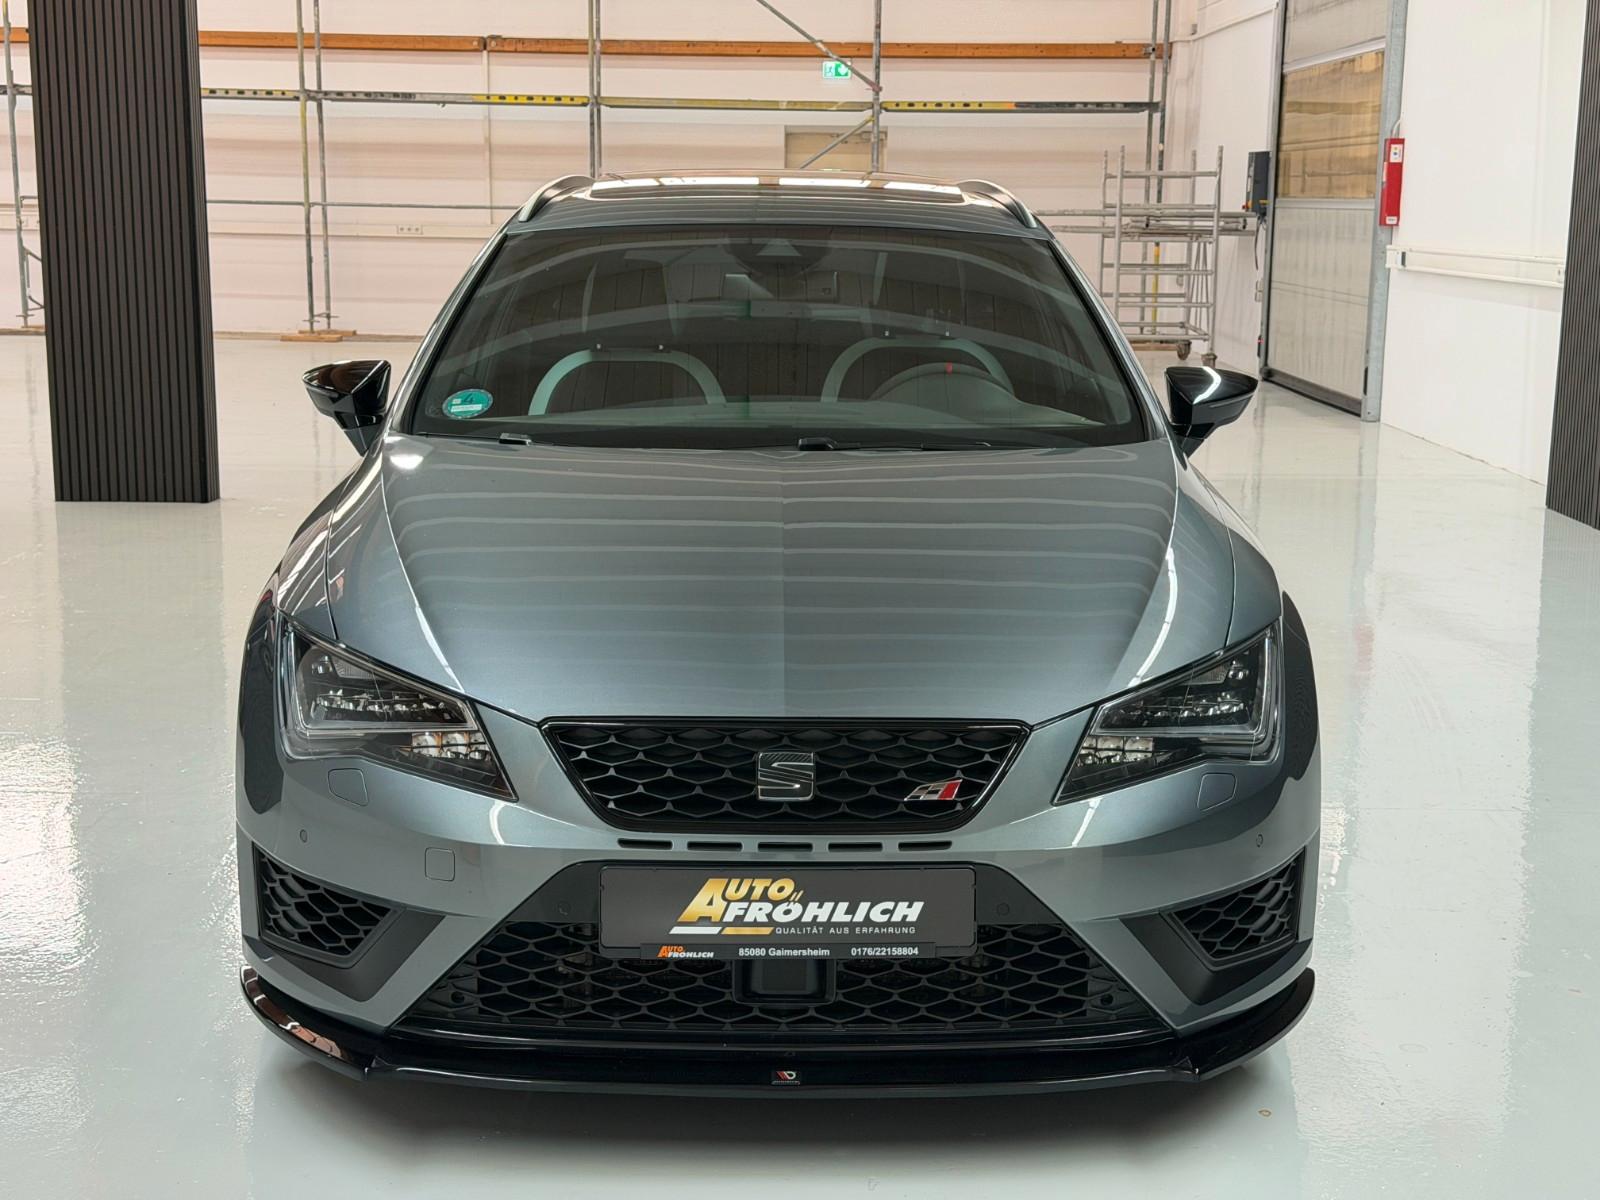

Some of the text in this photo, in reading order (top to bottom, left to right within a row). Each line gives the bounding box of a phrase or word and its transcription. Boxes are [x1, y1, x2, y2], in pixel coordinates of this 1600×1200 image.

[677, 878, 795, 922] AUTO
[722, 890, 924, 923] FRÖHLICH
[775, 926, 916, 935] QUALITÄT AUS ERFAHRUNG
[657, 945, 684, 958] AUTO
[738, 947, 830, 957] 85080 Gaimersheim
[851, 947, 919, 956] 0176/22158804
